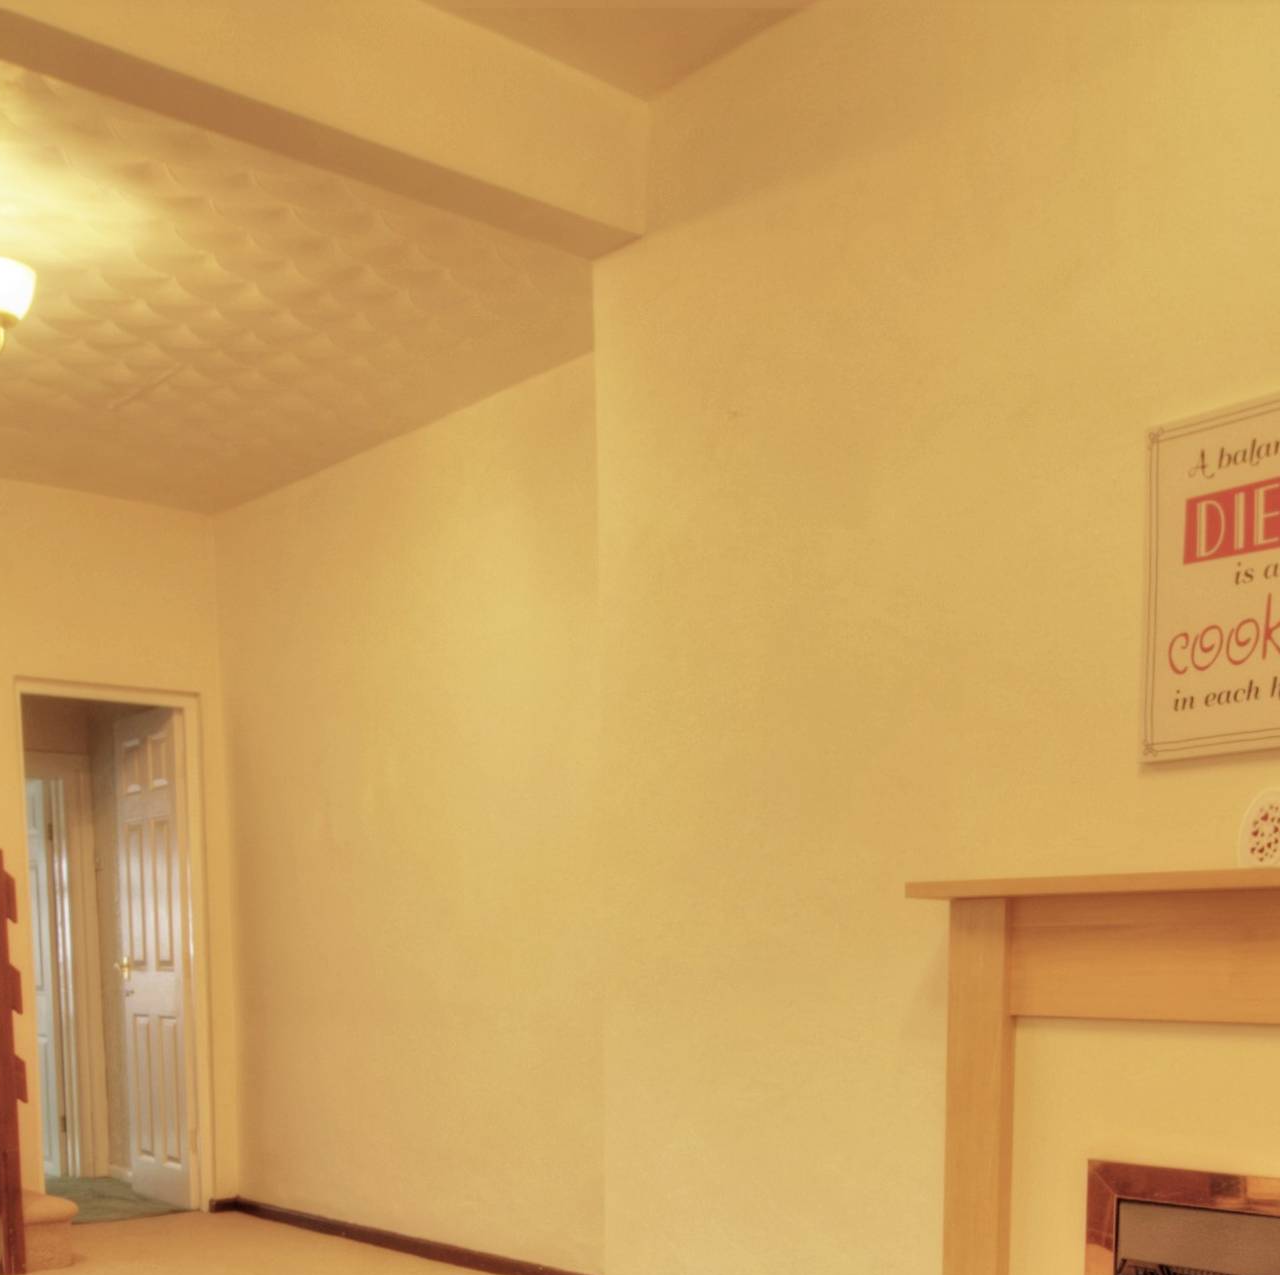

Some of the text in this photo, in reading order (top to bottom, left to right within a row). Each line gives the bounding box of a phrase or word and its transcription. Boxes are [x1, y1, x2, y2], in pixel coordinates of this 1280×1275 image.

[1187, 448, 1215, 479] A
[1233, 561, 1280, 586] is a
[1173, 688, 1195, 712] in
[1204, 678, 1260, 706] each
